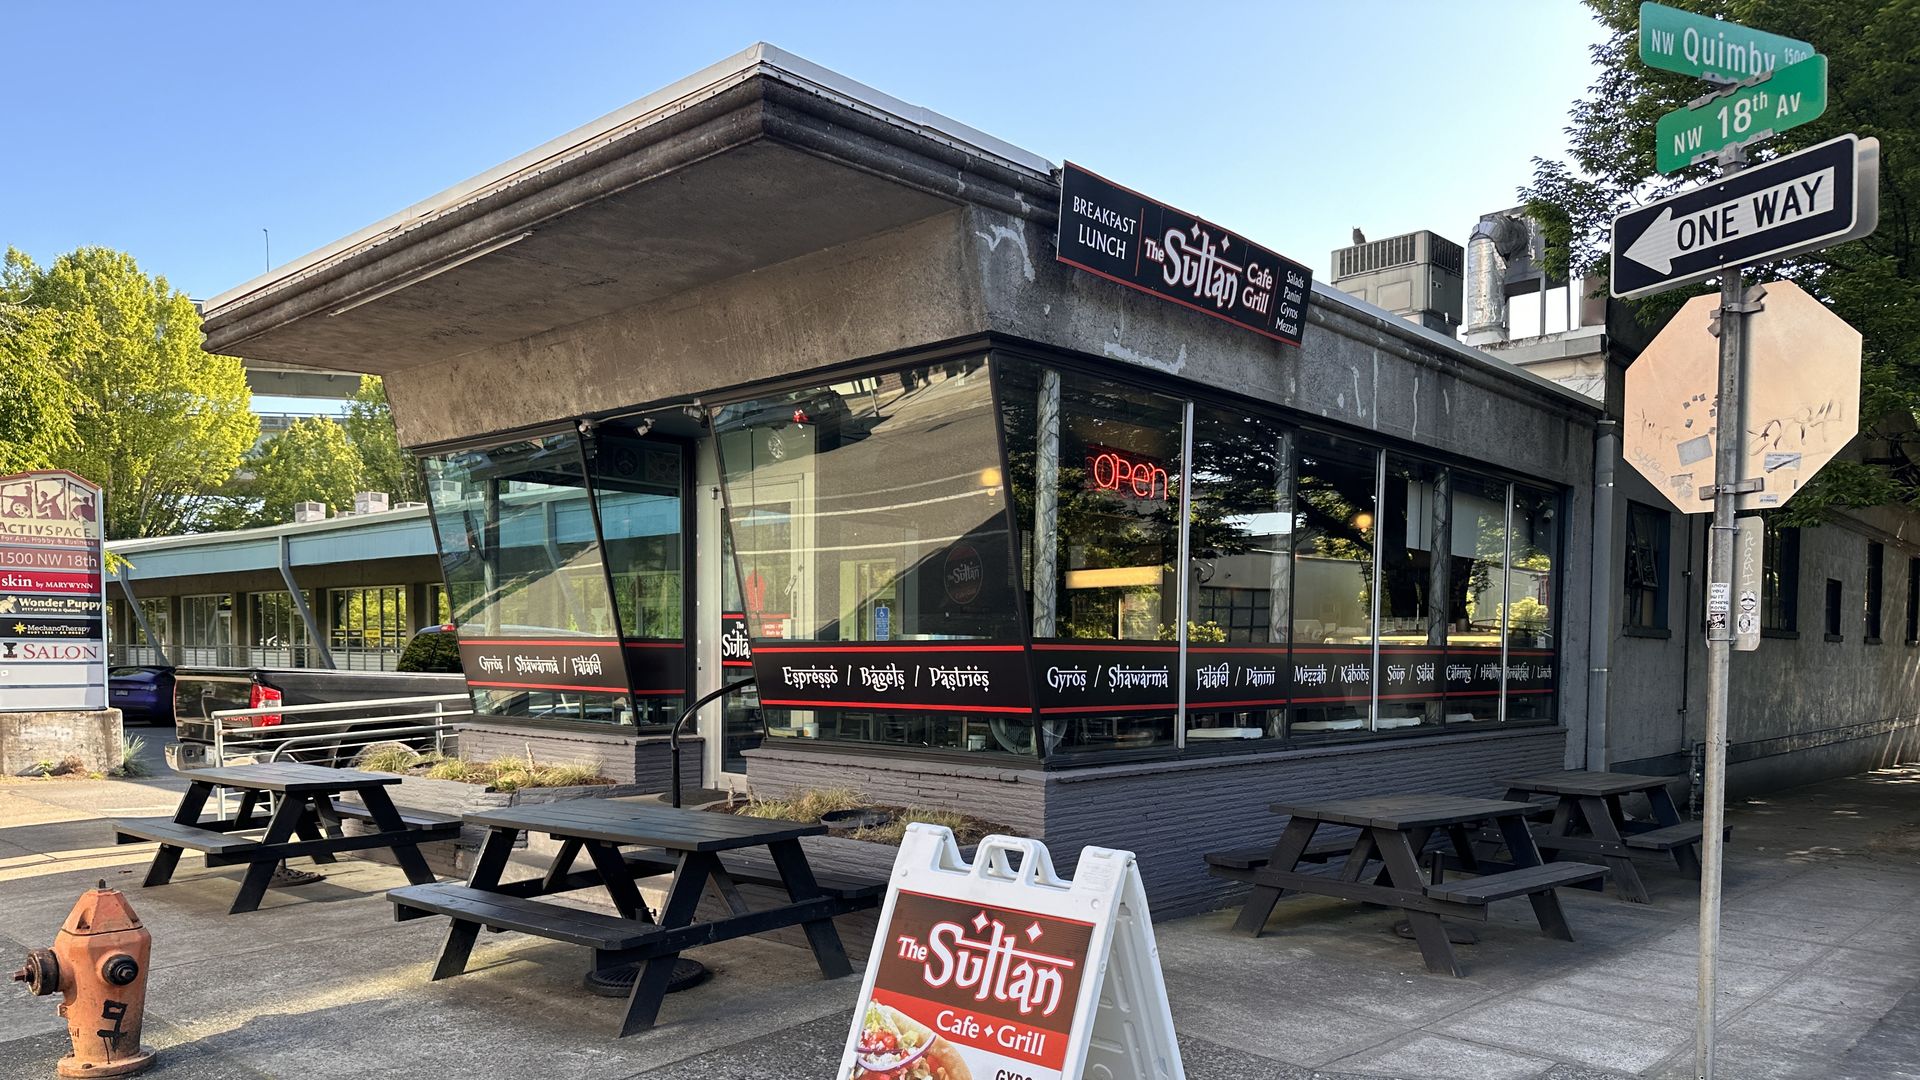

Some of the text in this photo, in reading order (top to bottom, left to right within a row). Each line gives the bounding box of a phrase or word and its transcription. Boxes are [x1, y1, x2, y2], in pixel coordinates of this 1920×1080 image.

[1651, 27, 1807, 76] NW Quimby 1500
[1673, 126, 1702, 156] NW
[1717, 91, 1768, 139] 18th
[1073, 195, 1137, 236] BREAKFAST
[1677, 176, 1824, 251] ONE WAY
[1078, 223, 1127, 260] LUNCH
[1145, 221, 1243, 310] The Sultan
[1247, 263, 1273, 290] Cafe
[1286, 270, 1304, 289] Salads
[1242, 286, 1269, 314] Grill
[1283, 286, 1302, 305] Panini
[1280, 302, 1299, 320] Gyros
[1275, 316, 1298, 337] Mezzah
[0, 521, 91, 538] ACTIVSPACE
[0, 552, 97, 567] 1500 NW 18th
[1, 574, 33, 587] skin
[18, 597, 101, 611] Wonder Puppy
[27, 624, 91, 634] MechanoTherapy
[736, 621, 744, 629] The
[23, 643, 98, 660] SALON
[722, 629, 751, 659] Sulta
[479, 655, 503, 674] Gyros
[514, 656, 560, 676] Shawarma
[571, 653, 602, 676] Falafel
[1197, 662, 1230, 691] Falafel
[1246, 666, 1276, 690] Panini
[1294, 664, 1328, 687] Mezzah
[1340, 663, 1371, 685] Kabobs
[1387, 664, 1406, 686] Soup
[1416, 662, 1436, 685] Salad
[1446, 663, 1472, 684] Catering
[782, 664, 839, 689] Espresso
[859, 663, 905, 692] Bagels
[928, 665, 990, 692] Pastries
[1046, 665, 1087, 693] Gyros
[1108, 664, 1169, 693] Shawarma
[899, 919, 1075, 1015] The Sultan
[936, 1010, 1046, 1057] Cafe Grill
